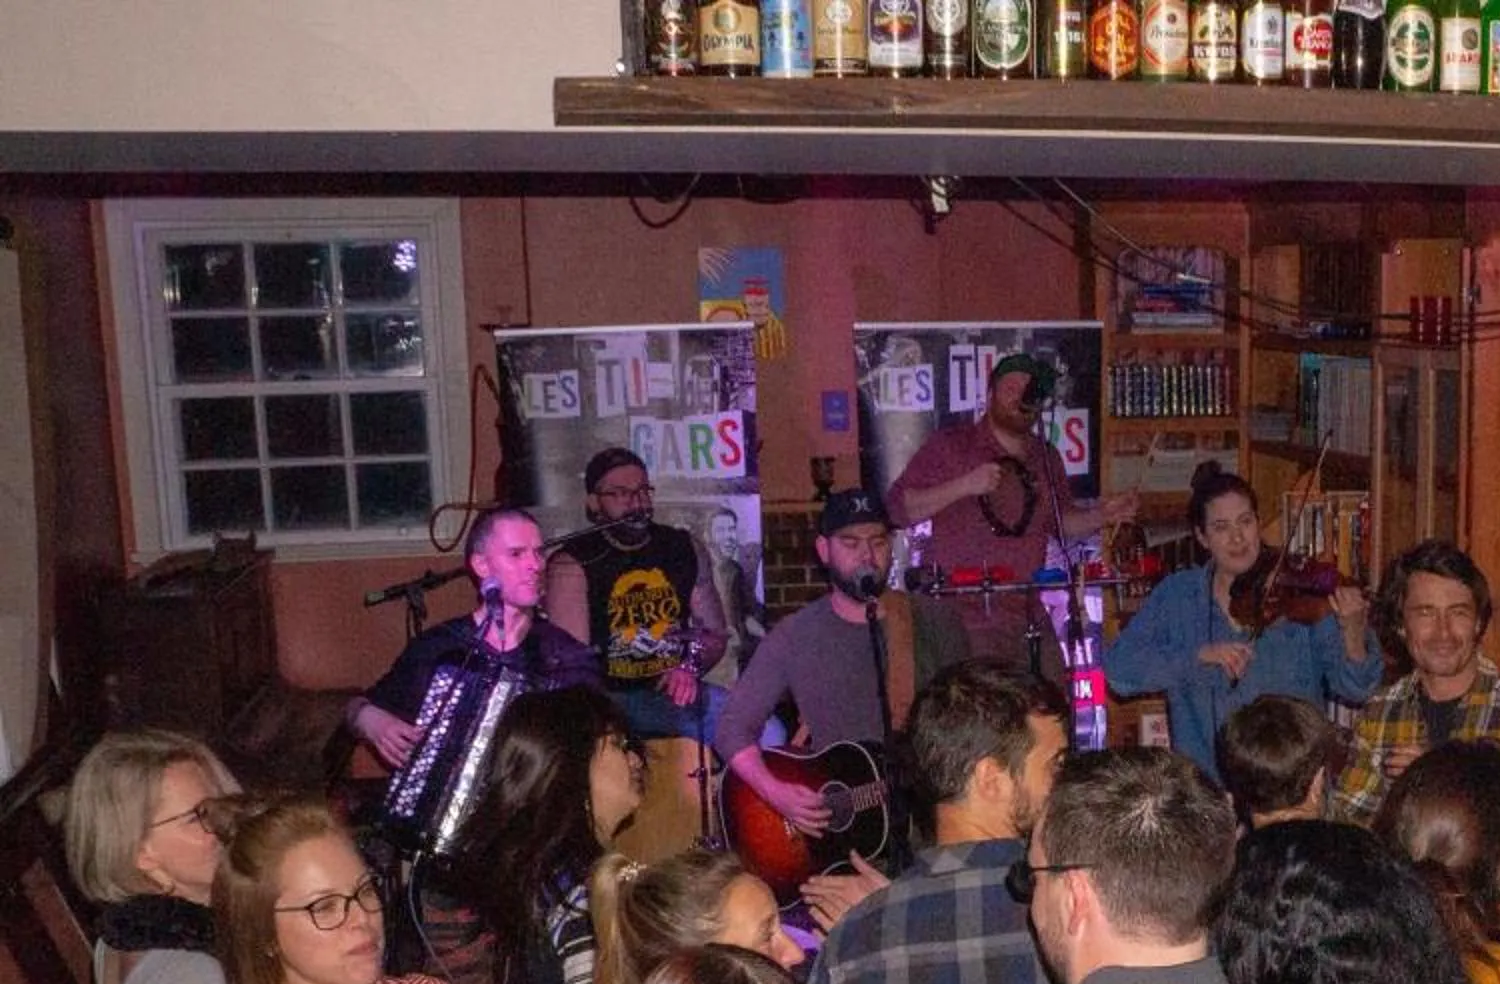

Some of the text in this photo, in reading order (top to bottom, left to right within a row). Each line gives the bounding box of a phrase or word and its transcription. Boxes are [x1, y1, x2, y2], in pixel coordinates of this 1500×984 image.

[527, 375, 578, 414] LES
[880, 369, 932, 407] LES
[633, 419, 742, 472] GARS
[608, 597, 681, 634] ZERO
